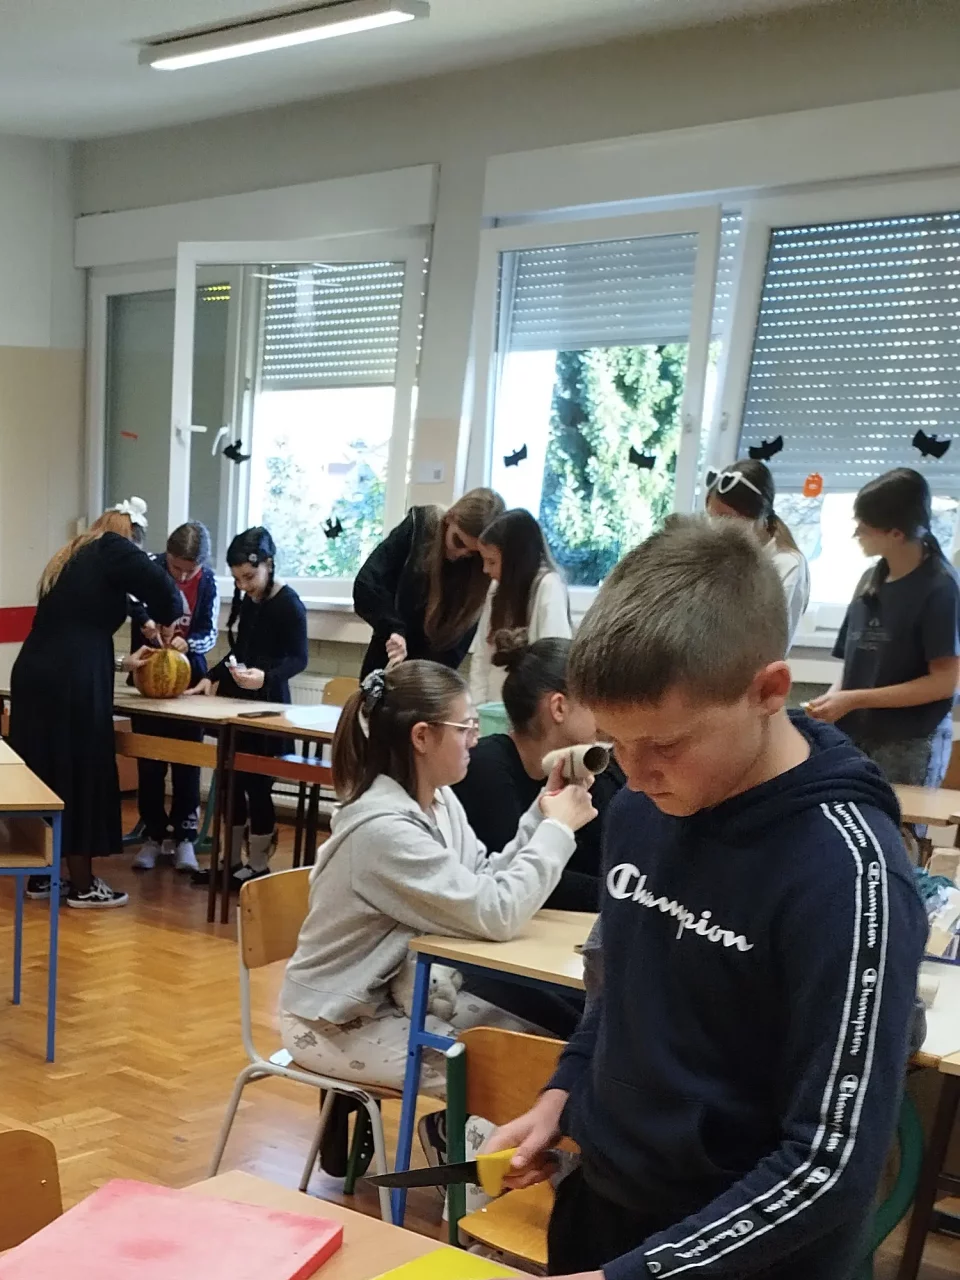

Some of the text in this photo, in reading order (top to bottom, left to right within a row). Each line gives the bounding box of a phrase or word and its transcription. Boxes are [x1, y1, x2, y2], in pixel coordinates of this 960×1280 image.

[833, 801, 868, 847] hampion
[606, 863, 754, 951] Champion
[863, 861, 880, 948] Champion
[850, 968, 878, 1055] Champion
